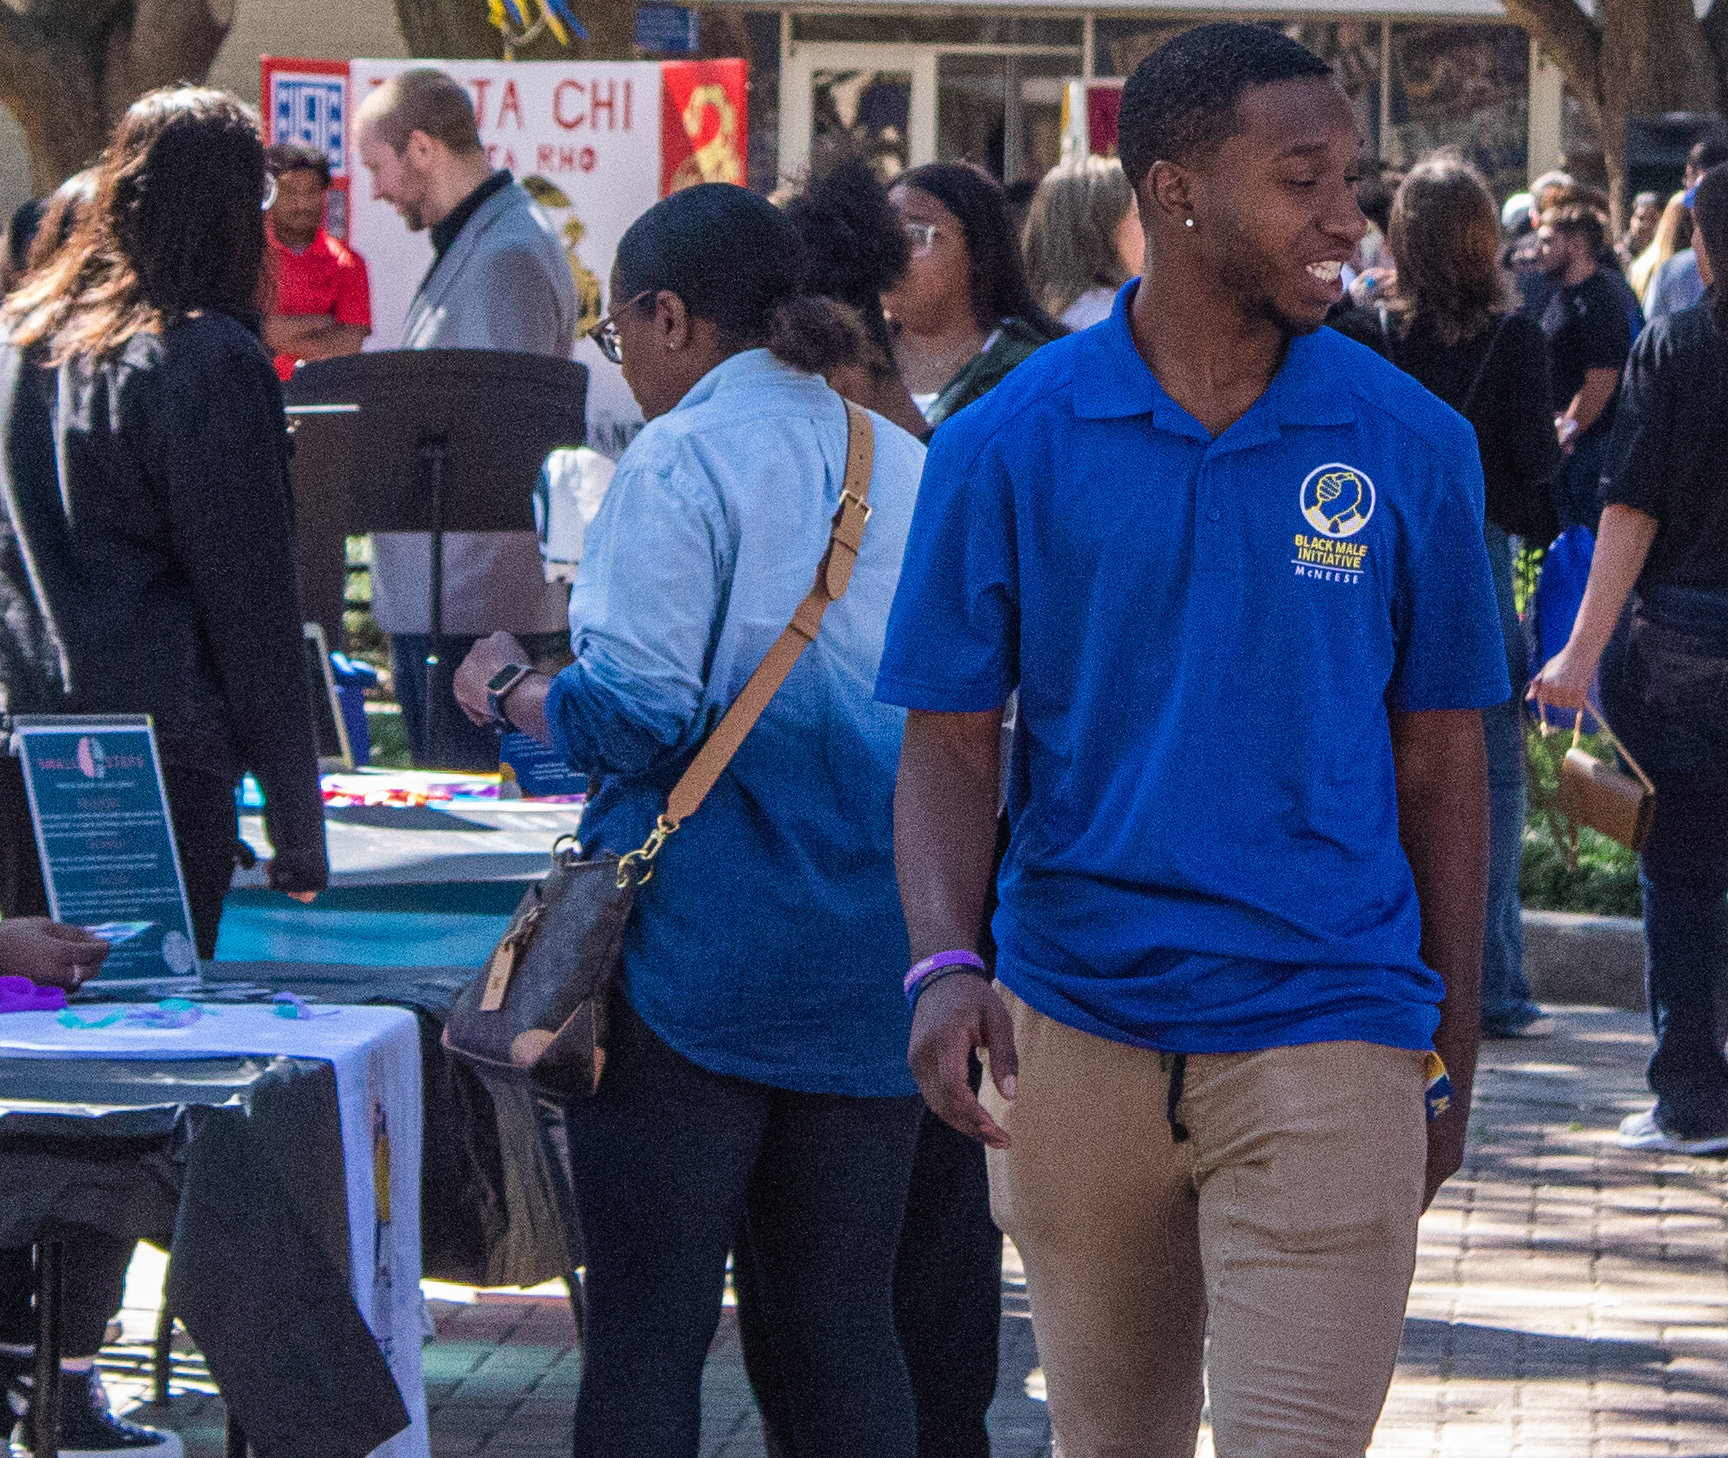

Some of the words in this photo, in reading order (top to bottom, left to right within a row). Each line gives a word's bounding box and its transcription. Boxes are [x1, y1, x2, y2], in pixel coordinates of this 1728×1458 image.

[552, 78, 633, 131] CHI
[536, 145, 597, 173] RHO
[1295, 534, 1334, 551] BLACK
[1336, 541, 1367, 556] MALE
[1298, 548, 1361, 568] INITIATIVE
